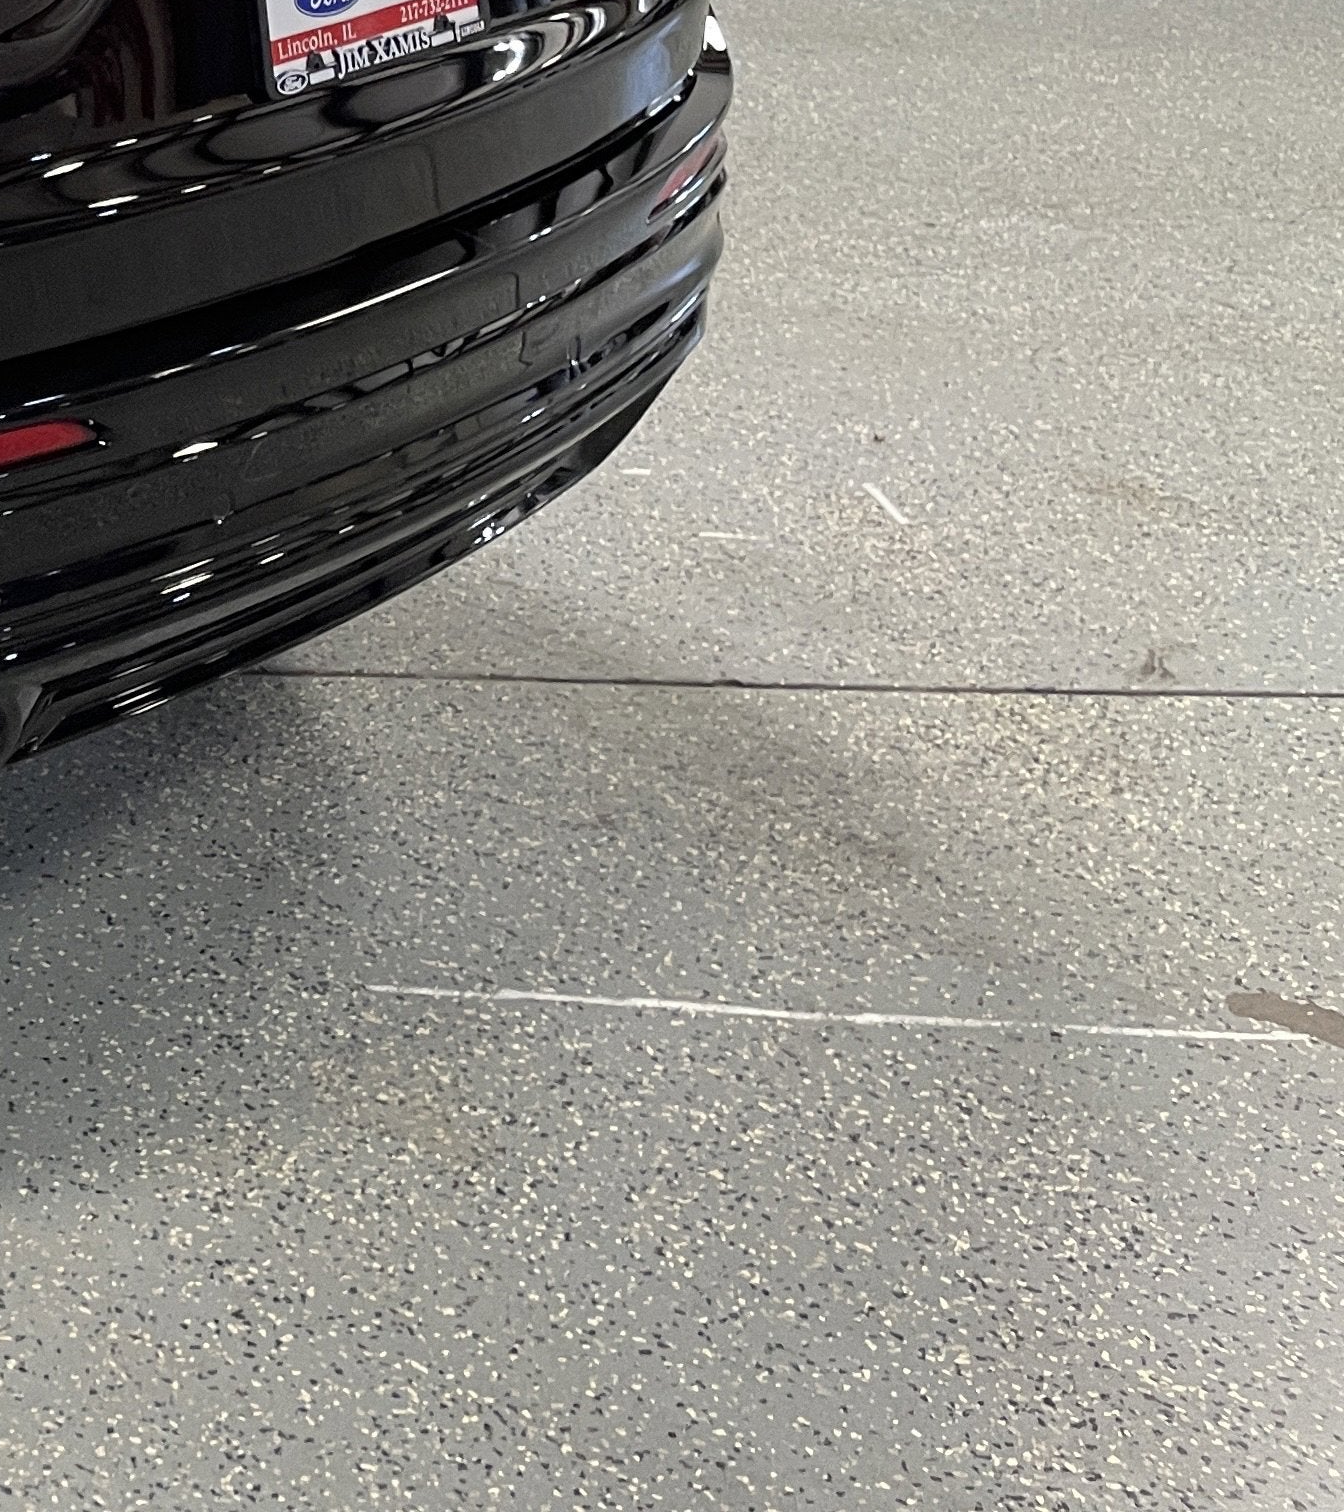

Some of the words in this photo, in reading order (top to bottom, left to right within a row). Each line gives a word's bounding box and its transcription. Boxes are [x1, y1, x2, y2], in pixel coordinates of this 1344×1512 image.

[342, 23, 357, 41] IL
[337, 48, 371, 80] JIM
[373, 30, 431, 65] XAMIS
